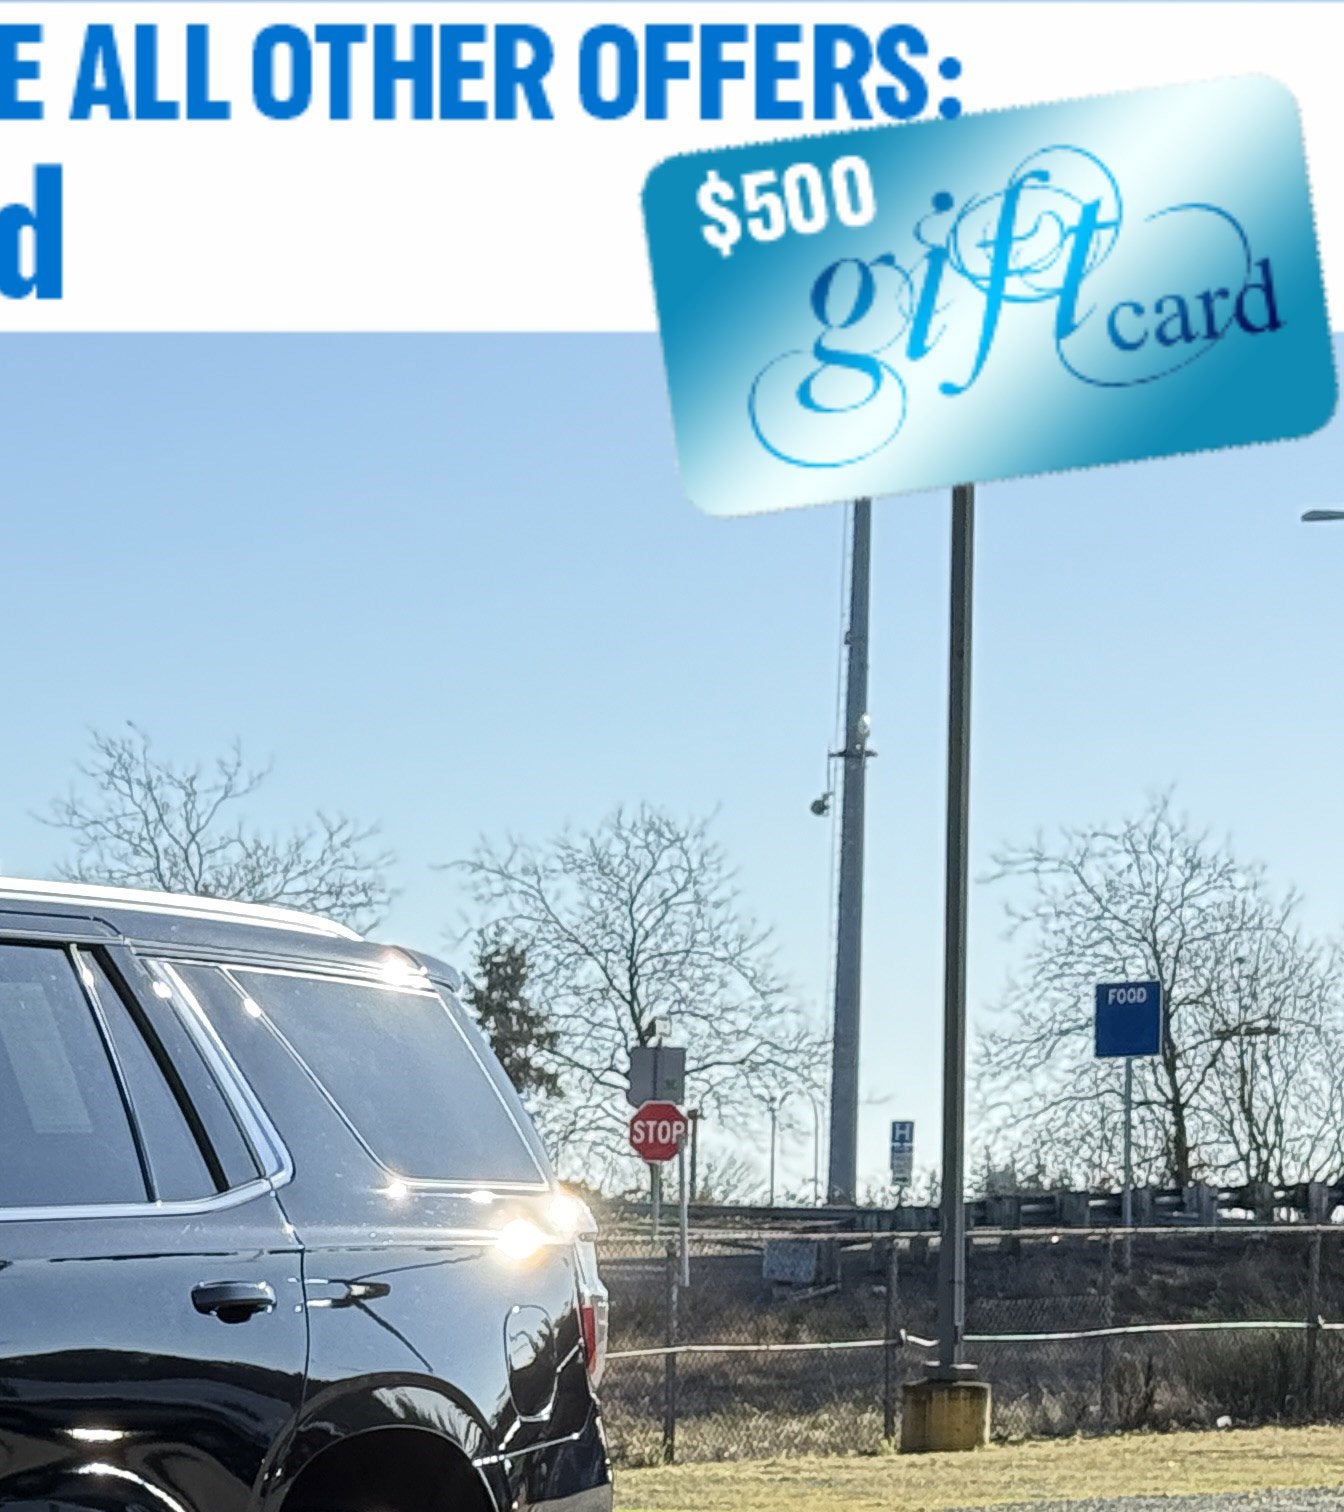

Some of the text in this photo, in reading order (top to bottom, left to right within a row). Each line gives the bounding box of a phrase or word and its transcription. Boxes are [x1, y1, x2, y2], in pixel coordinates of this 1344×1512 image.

[1107, 986, 1148, 1006] FOOD
[632, 1119, 685, 1144] STOP
[894, 1123, 911, 1141] H
